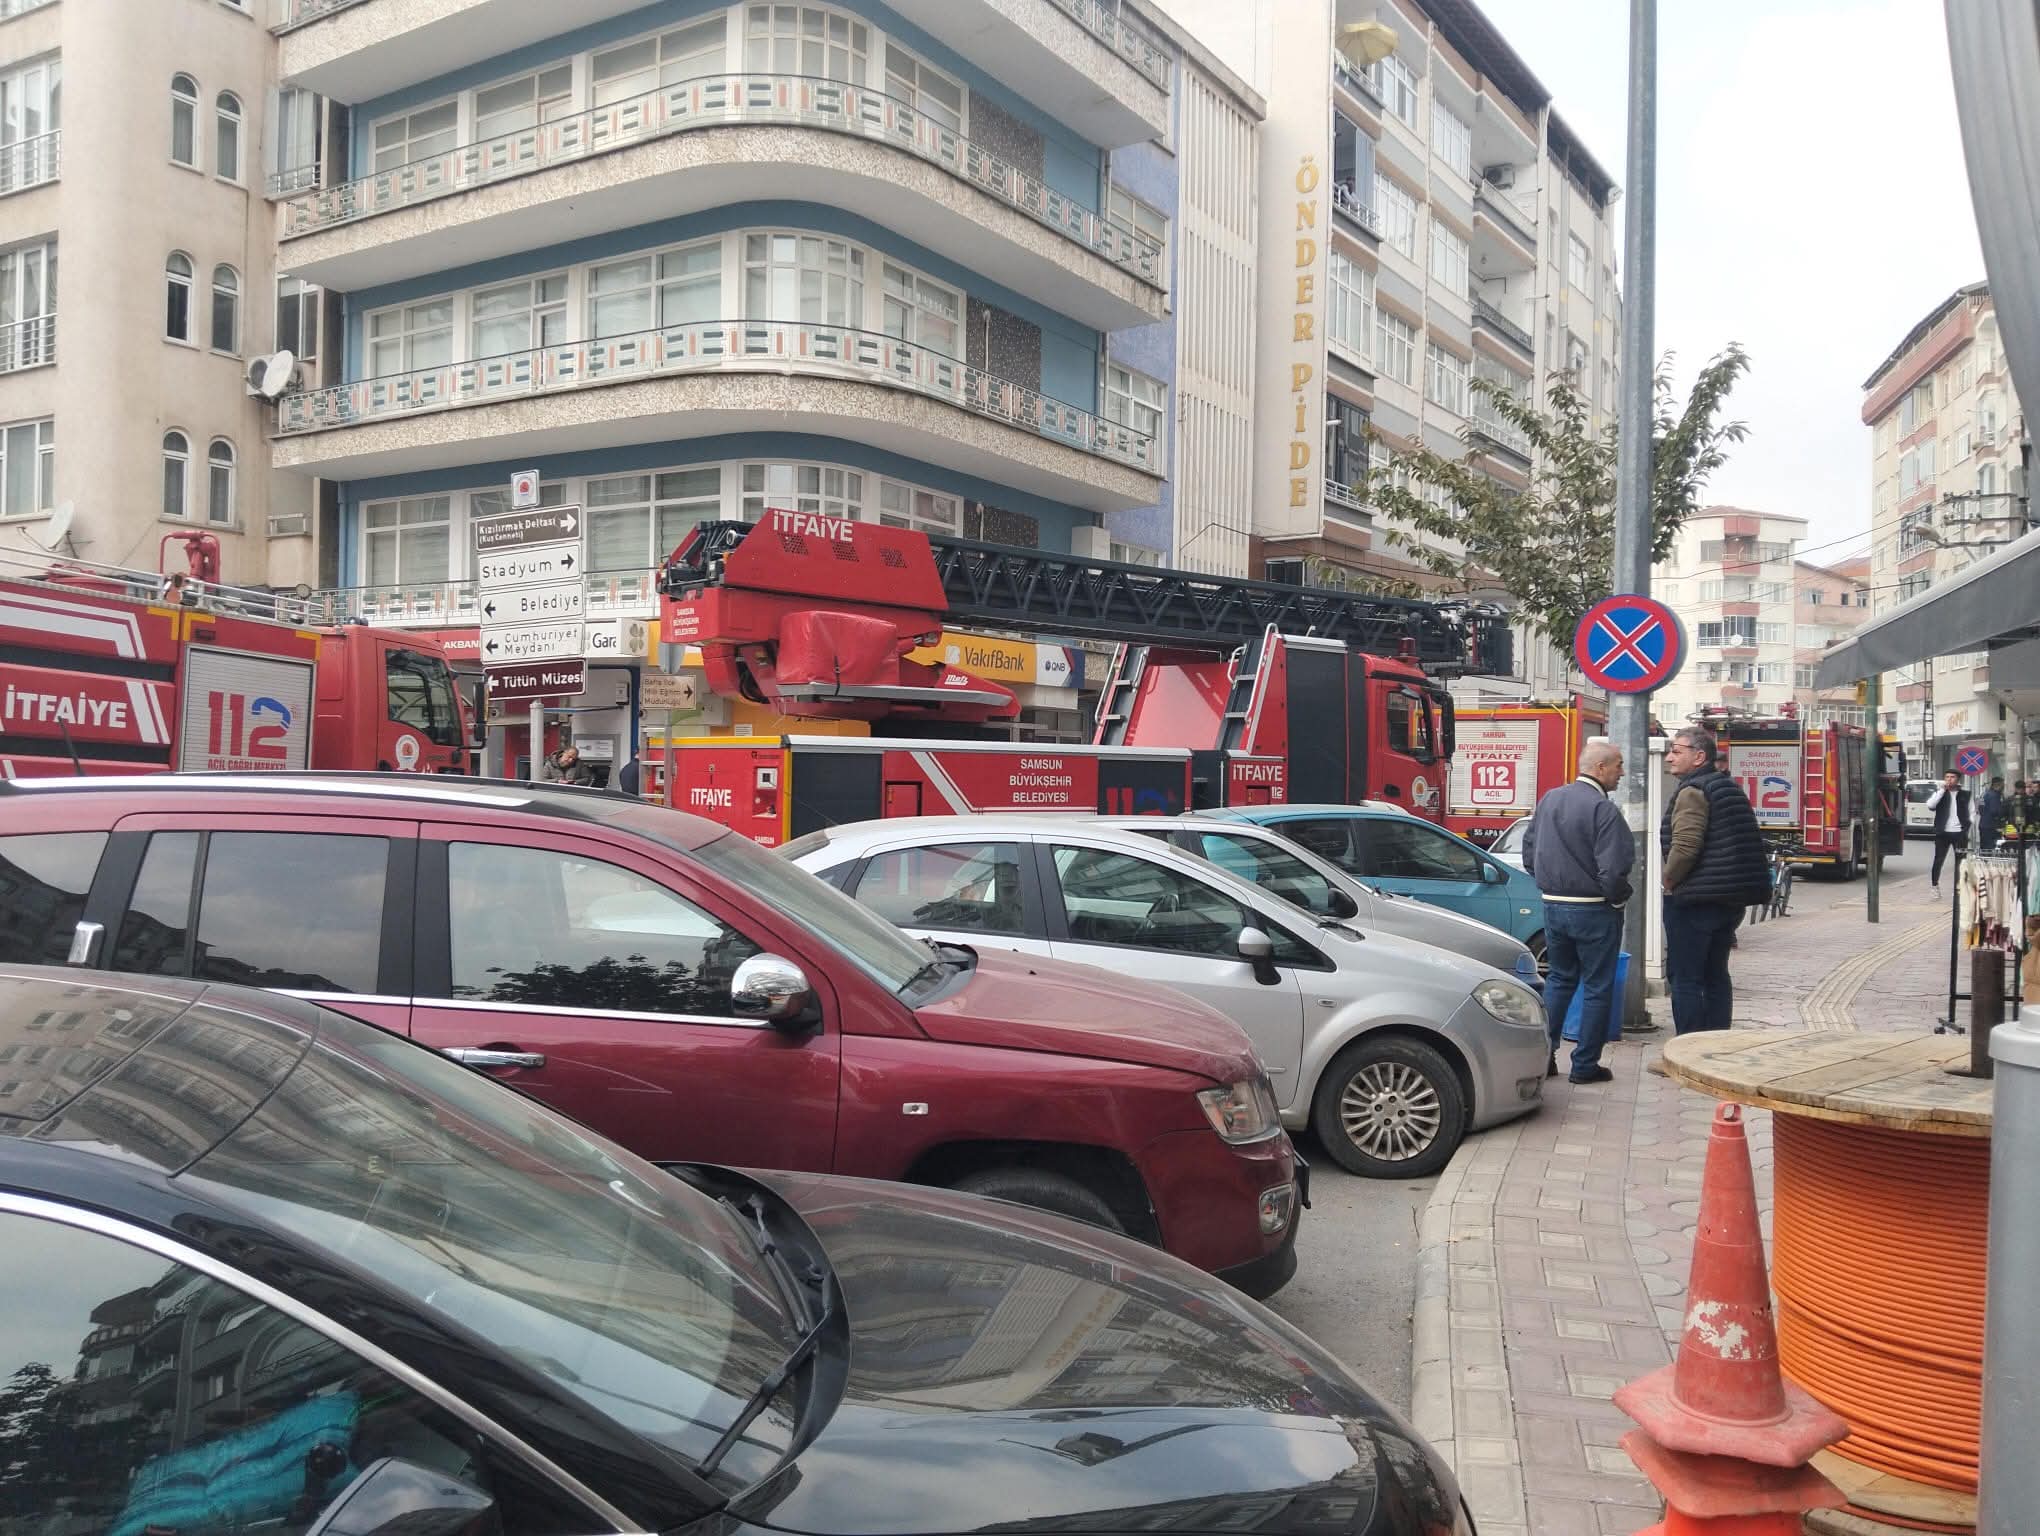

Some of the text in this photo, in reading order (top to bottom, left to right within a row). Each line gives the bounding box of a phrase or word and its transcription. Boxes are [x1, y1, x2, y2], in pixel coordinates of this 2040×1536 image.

[1289, 154, 1319, 507] ÖNDER PİDE
[479, 517, 556, 535] Kızılırmak Deltası
[773, 511, 853, 542] İTFAİYE
[482, 560, 552, 578] Stadyum
[521, 595, 579, 612] Belediye
[444, 640, 481, 649] AKBAN
[504, 628, 578, 644] Cumhuriyet
[504, 642, 555, 656] Meydanı
[964, 646, 1024, 672] VakıfBank
[502, 671, 584, 688] Tütün Müzesi
[5, 684, 128, 728] İTFAİYE
[208, 690, 291, 760] 112
[1020, 758, 1062, 769] SAMSUN
[1009, 773, 1072, 788] BÜYÜKŞEHİR
[1232, 764, 1283, 781] İTFAİYE
[1477, 766, 1510, 786] 112
[1013, 792, 1069, 803] BELEDİYESİ
